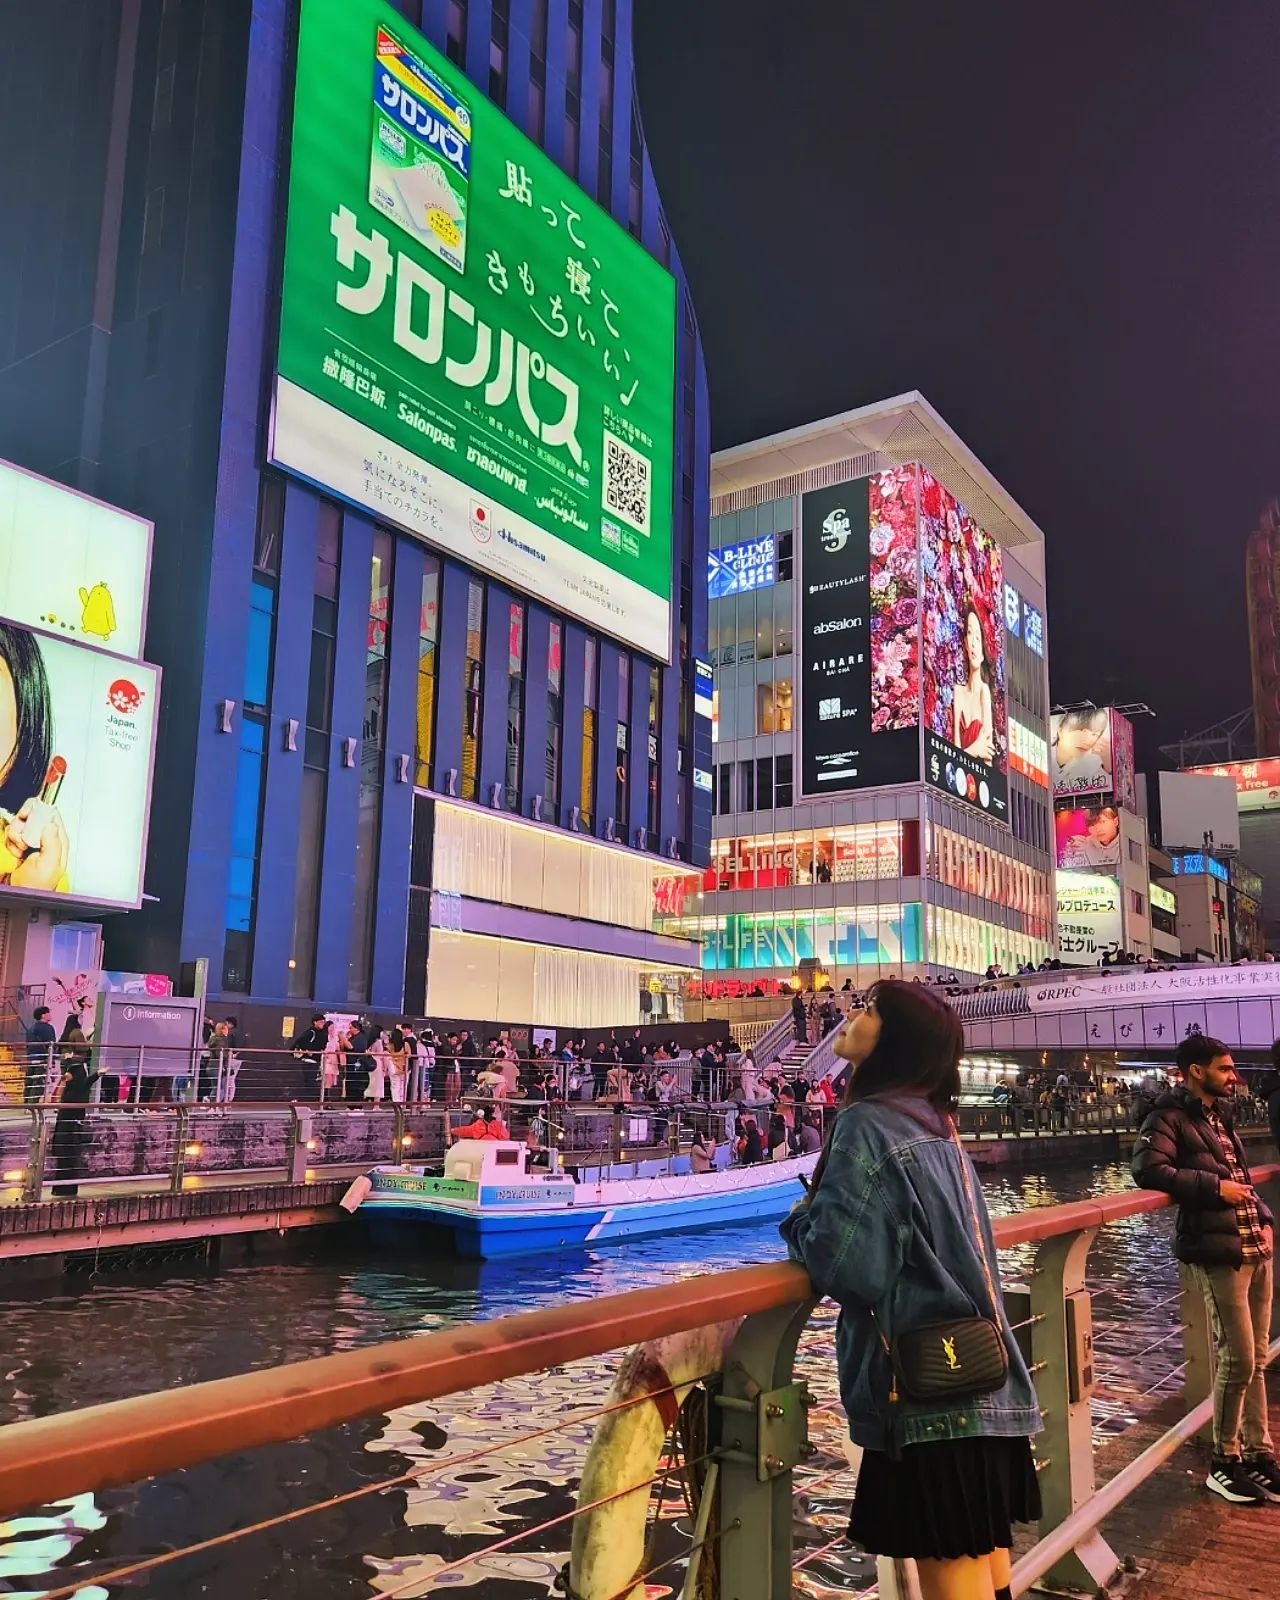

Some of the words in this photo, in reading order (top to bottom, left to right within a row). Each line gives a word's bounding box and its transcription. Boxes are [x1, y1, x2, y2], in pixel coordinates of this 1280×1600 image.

[382, 73, 468, 174] サロンパス
[330, 203, 583, 469] サロンパス
[497, 527, 546, 563] Hisamitsu
[724, 539, 774, 563] B-LINE
[732, 551, 774, 570] CLINIC
[813, 617, 862, 635] abSalon
[813, 653, 864, 671] AIRARE
[108, 737, 132, 752] Shop
